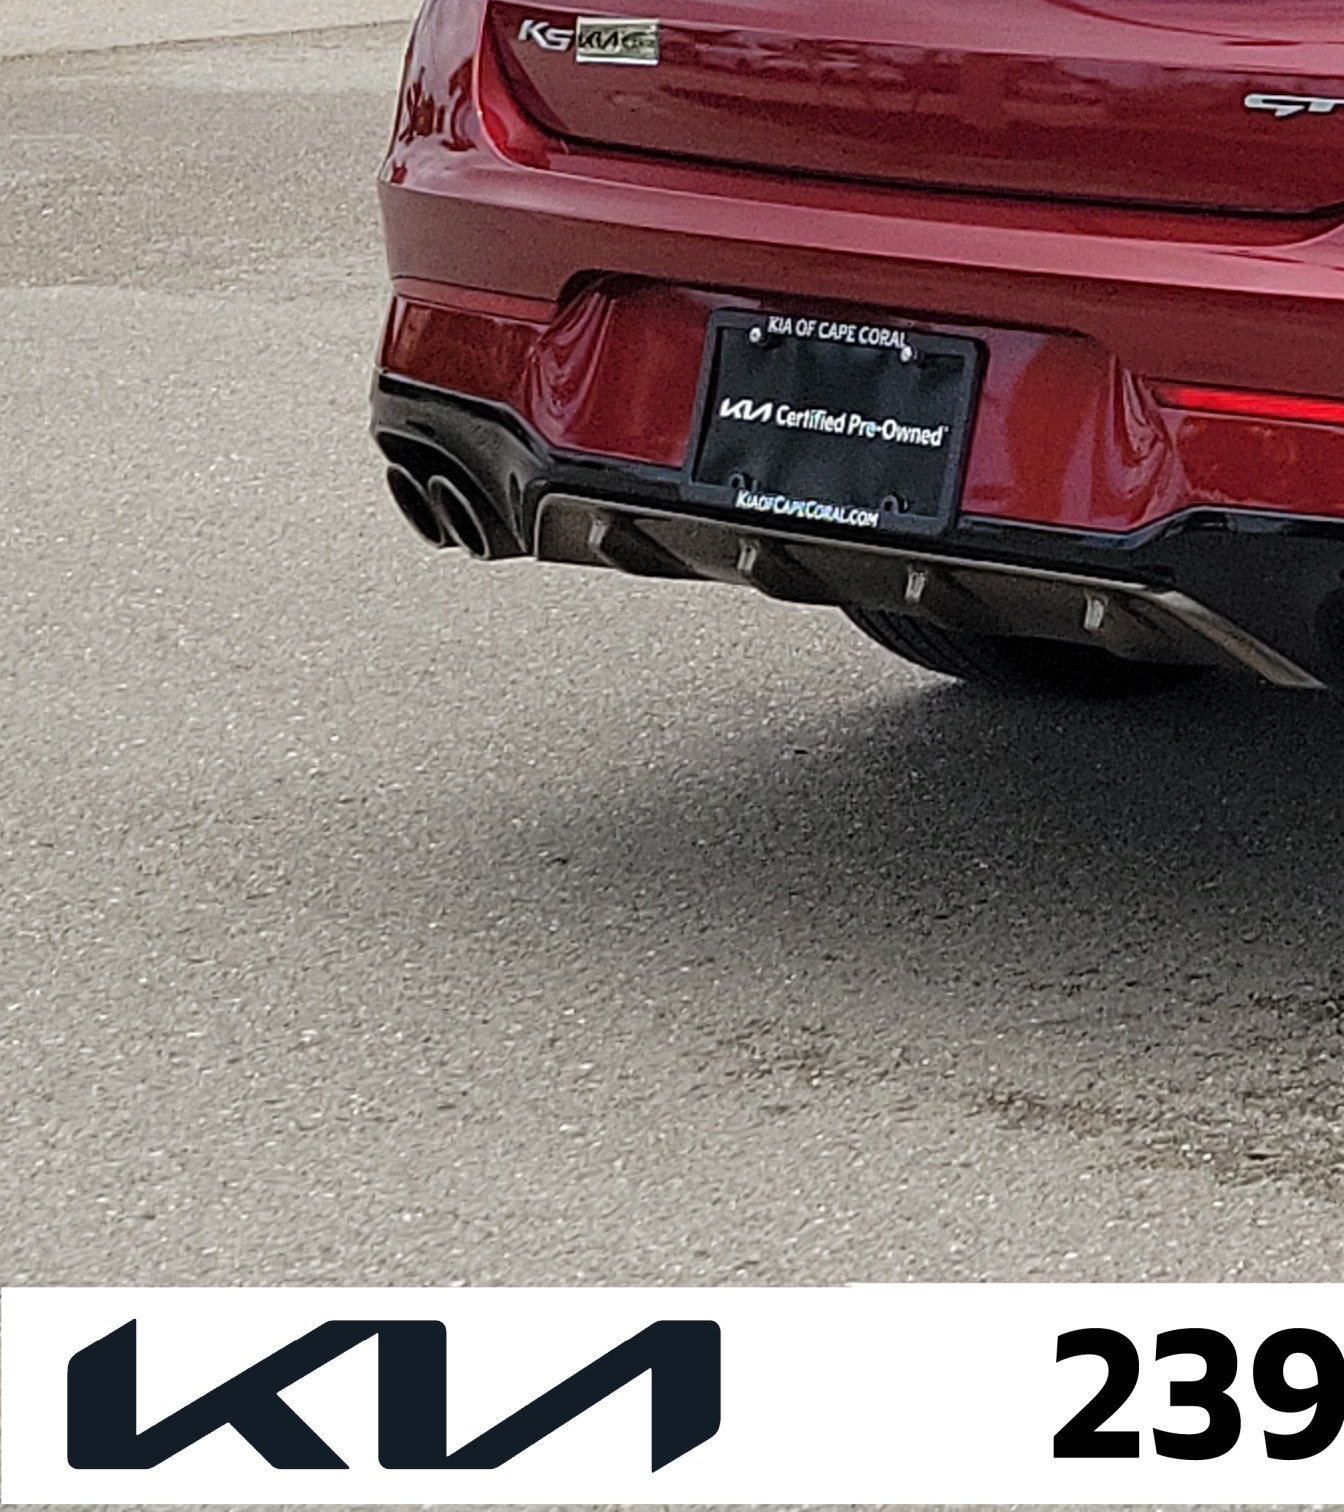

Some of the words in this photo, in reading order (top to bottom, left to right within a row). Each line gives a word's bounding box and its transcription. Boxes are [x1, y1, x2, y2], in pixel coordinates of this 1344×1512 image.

[767, 315, 792, 336] KIA
[795, 318, 818, 338] OF
[818, 321, 858, 344] CAPE
[858, 326, 906, 349] CORAL
[718, 397, 774, 423] KIA
[775, 404, 847, 435] Certified
[847, 412, 945, 448] Pre-Owned
